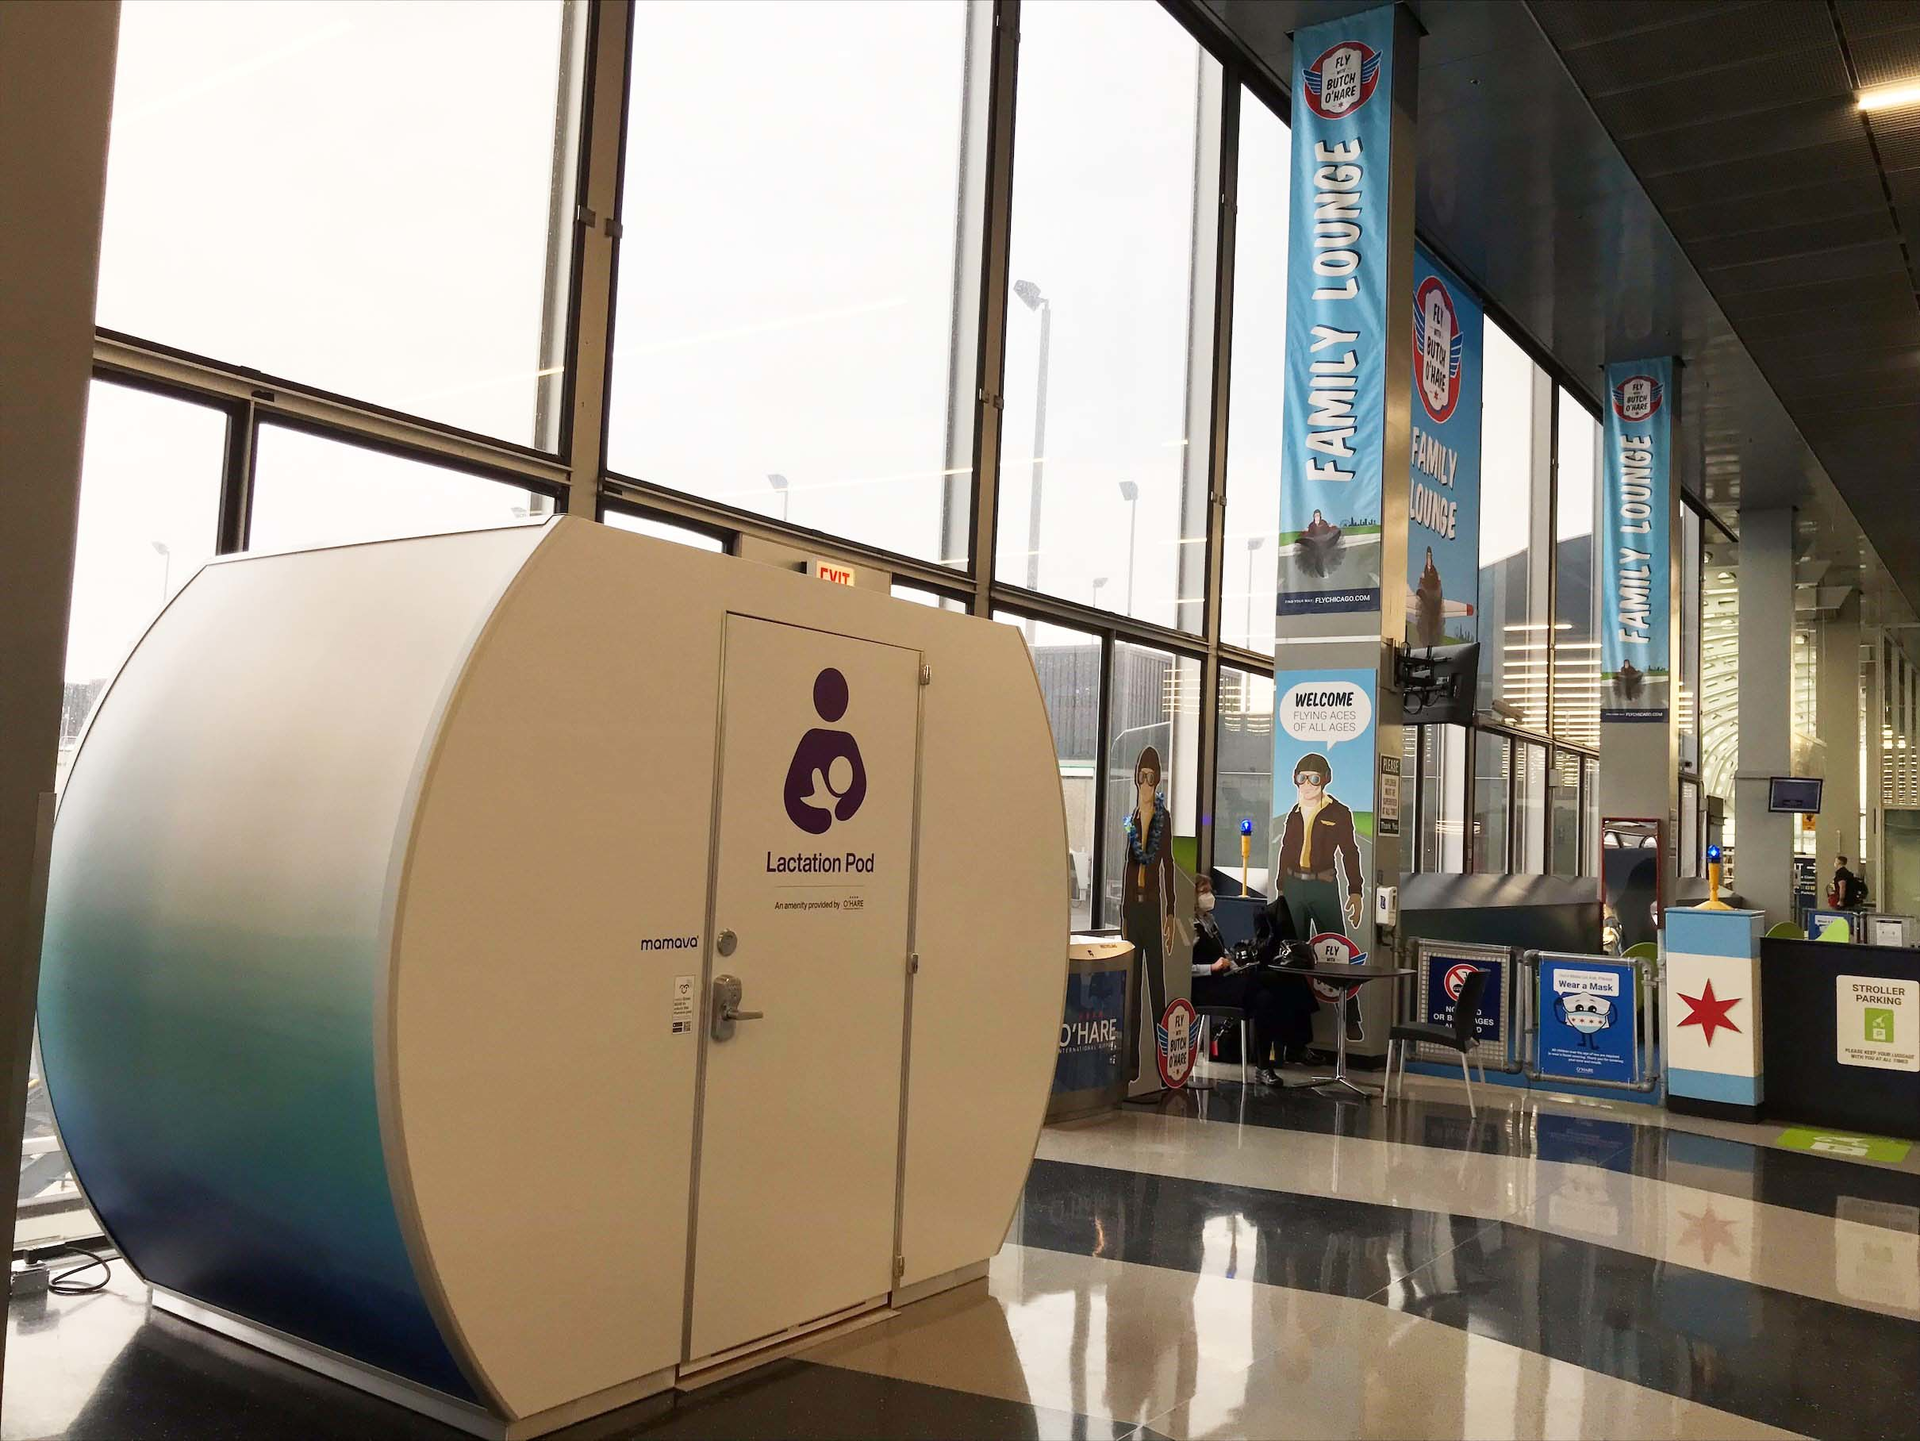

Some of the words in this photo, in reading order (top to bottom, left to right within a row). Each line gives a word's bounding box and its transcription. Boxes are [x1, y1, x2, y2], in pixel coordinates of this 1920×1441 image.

[1335, 54, 1351, 69] FLY
[1326, 72, 1356, 90] BUTCH
[1325, 86, 1357, 103] O'HARE
[1311, 137, 1363, 300] LOUNGE
[1433, 304, 1444, 328] FLY
[1427, 336, 1447, 368] BUTCH
[1425, 361, 1446, 392] O'HARE
[1632, 383, 1644, 391] FLY
[1305, 324, 1360, 482] FAMILY
[1627, 395, 1648, 404] BUTCH
[1626, 403, 1648, 412] O'HARE
[1411, 426, 1458, 491] FAMILY
[1620, 434, 1653, 534] LOUNGE
[1410, 478, 1458, 540] LOUNGE
[1315, 595, 1370, 604] FLYCHICAGO.COM
[1618, 547, 1651, 644] FAMILY
[1295, 691, 1354, 707] WELCOME
[1293, 711, 1327, 720] FLYING
[1329, 711, 1356, 719] ACES
[1293, 723, 1306, 732] OF
[1308, 723, 1326, 731] ALL
[1328, 722, 1356, 731] AGES
[1383, 758, 1399, 773] PLEASE
[766, 851, 841, 873] Lactation
[845, 853, 875, 873] Pod
[775, 901, 783, 909] An
[784, 900, 807, 910] amenity
[808, 900, 834, 910] provided
[834, 900, 841, 909] by
[843, 899, 864, 908] O'HARE
[640, 936, 698, 951] mamava
[1325, 945, 1340, 956] FLY
[1559, 980, 1580, 989] Wear
[1589, 983, 1613, 991] Mask
[1852, 984, 1905, 996] STROLLER
[1856, 994, 1902, 1006] PARKING
[1175, 1015, 1184, 1028] FLY
[1433, 1013, 1445, 1021] OR
[1059, 1018, 1117, 1048] O'HARE
[1170, 1037, 1187, 1053] BUTCH
[1169, 1052, 1187, 1068] O'HARE
